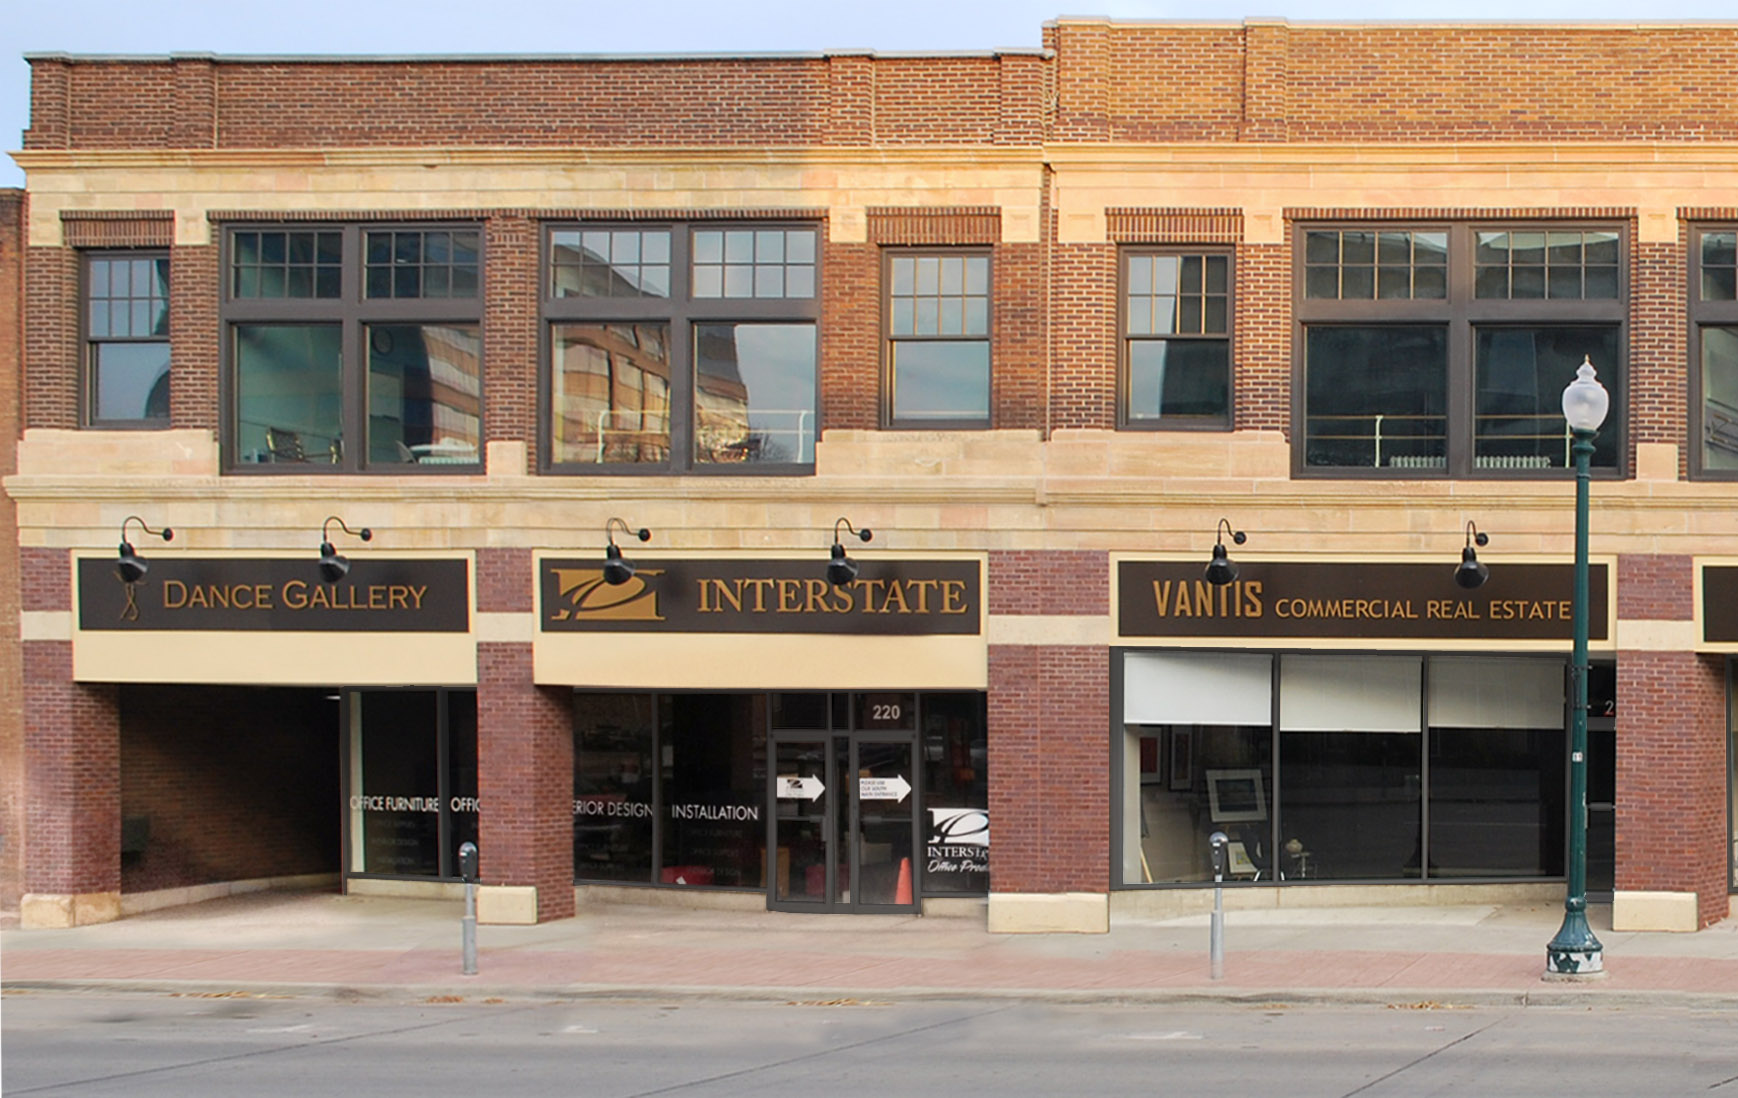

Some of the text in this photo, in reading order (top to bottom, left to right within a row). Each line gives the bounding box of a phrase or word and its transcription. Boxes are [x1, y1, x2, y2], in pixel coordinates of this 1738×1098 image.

[163, 579, 428, 610] DANCE GALLERY
[696, 577, 969, 615] INTERSTATE
[1152, 580, 1573, 620] VANTIS COMMERCIAL REAL ESTATE
[872, 704, 901, 720] 220
[350, 796, 440, 813] OFFICE FURNITURE
[606, 801, 653, 819] DESIGN
[671, 803, 760, 822] INSTALLATION
